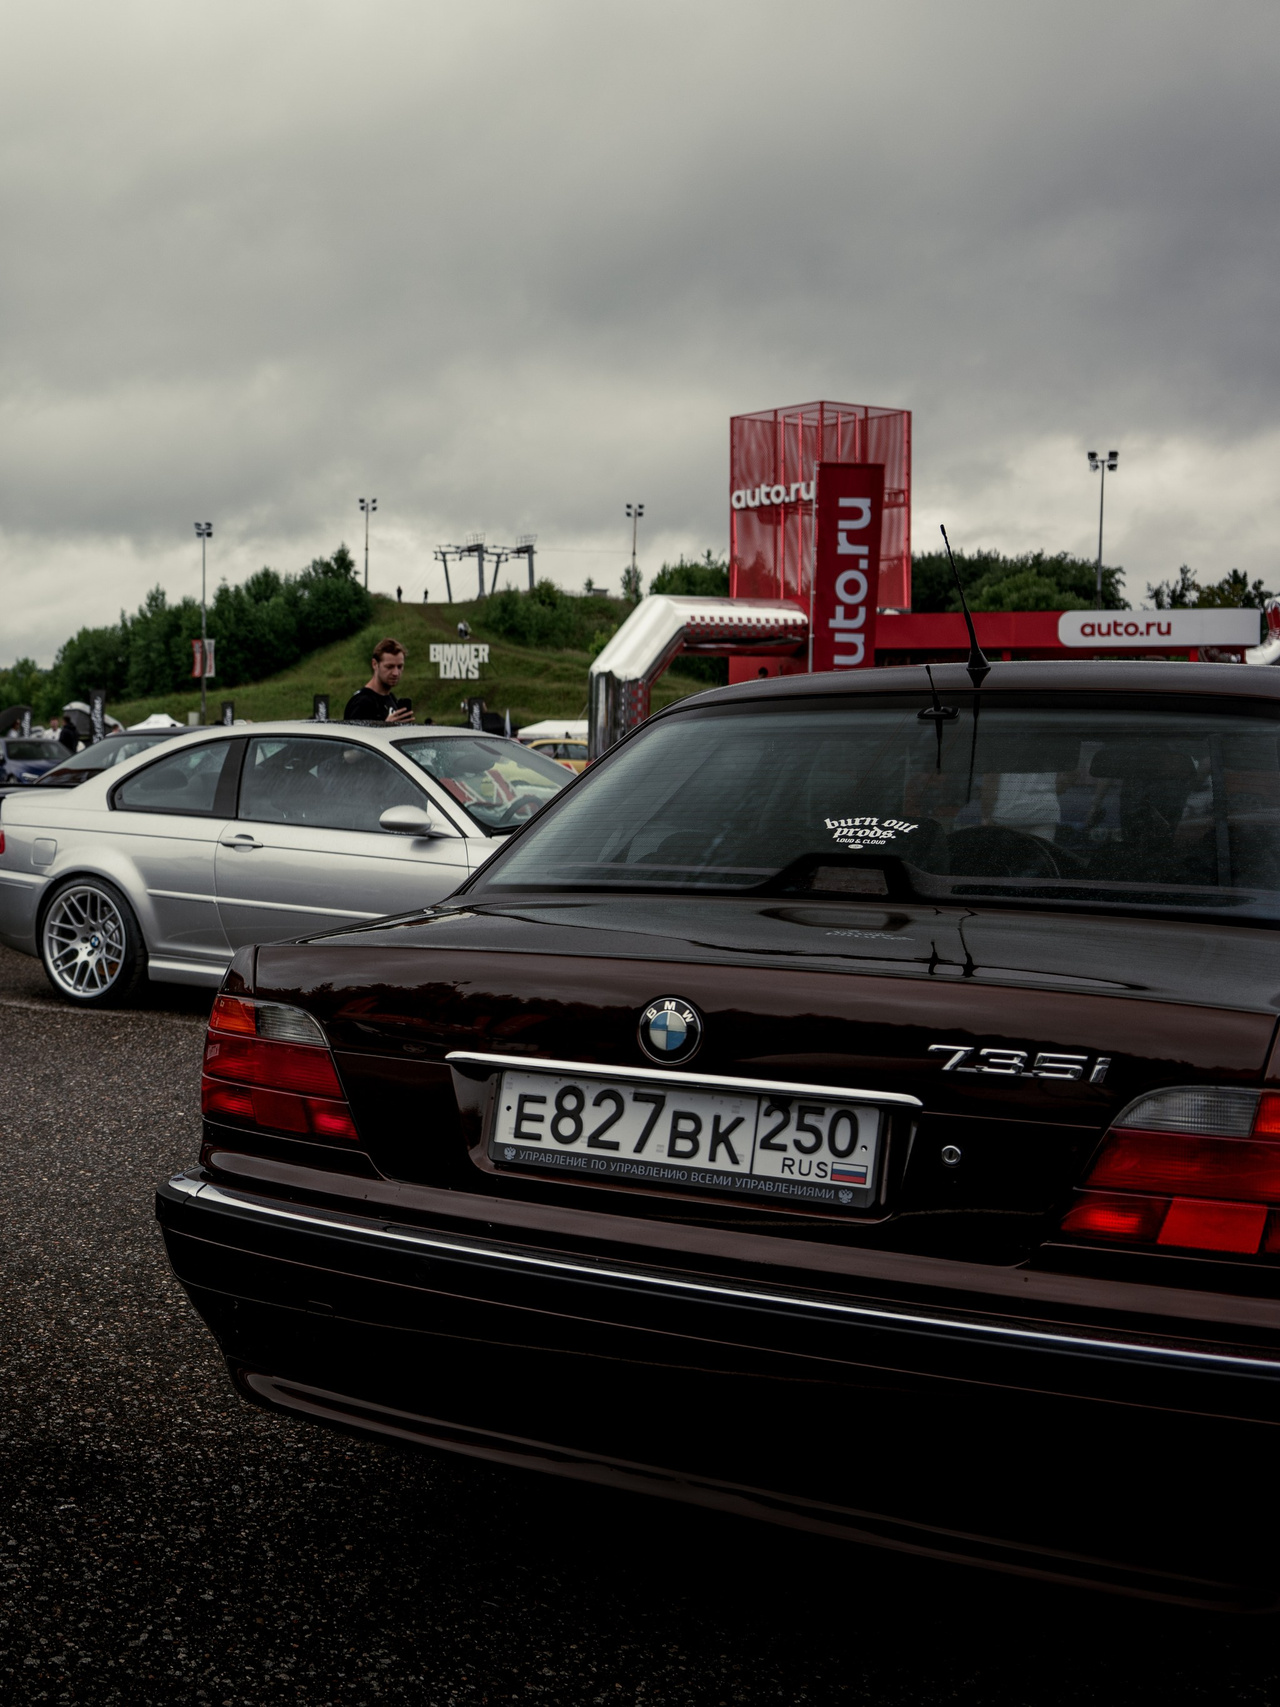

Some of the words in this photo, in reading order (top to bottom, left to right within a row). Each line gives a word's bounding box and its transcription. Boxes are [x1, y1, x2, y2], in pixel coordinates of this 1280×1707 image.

[731, 480, 815, 510] auto.ru
[828, 497, 872, 671] uto.ru
[1080, 620, 1172, 637] auto.ru
[429, 643, 490, 663] BIMMER
[439, 660, 480, 680] DAYS
[824, 817, 880, 829] burn
[881, 819, 919, 833] out
[832, 826, 897, 839] prods.
[645, 1000, 695, 1024] BMW
[927, 1044, 1112, 1083] 735i
[759, 1096, 859, 1158] 250
[518, 1149, 588, 1169] УПРАВЛЕНИЕ
[590, 1157, 607, 1171] ПО
[609, 1161, 689, 1182] УПРАВЛЕНИЮ
[691, 1171, 732, 1187] ВСЕМИ
[735, 1177, 835, 1200] УПРАВЛЕНИЯМИ
[781, 1156, 829, 1179] RUS
